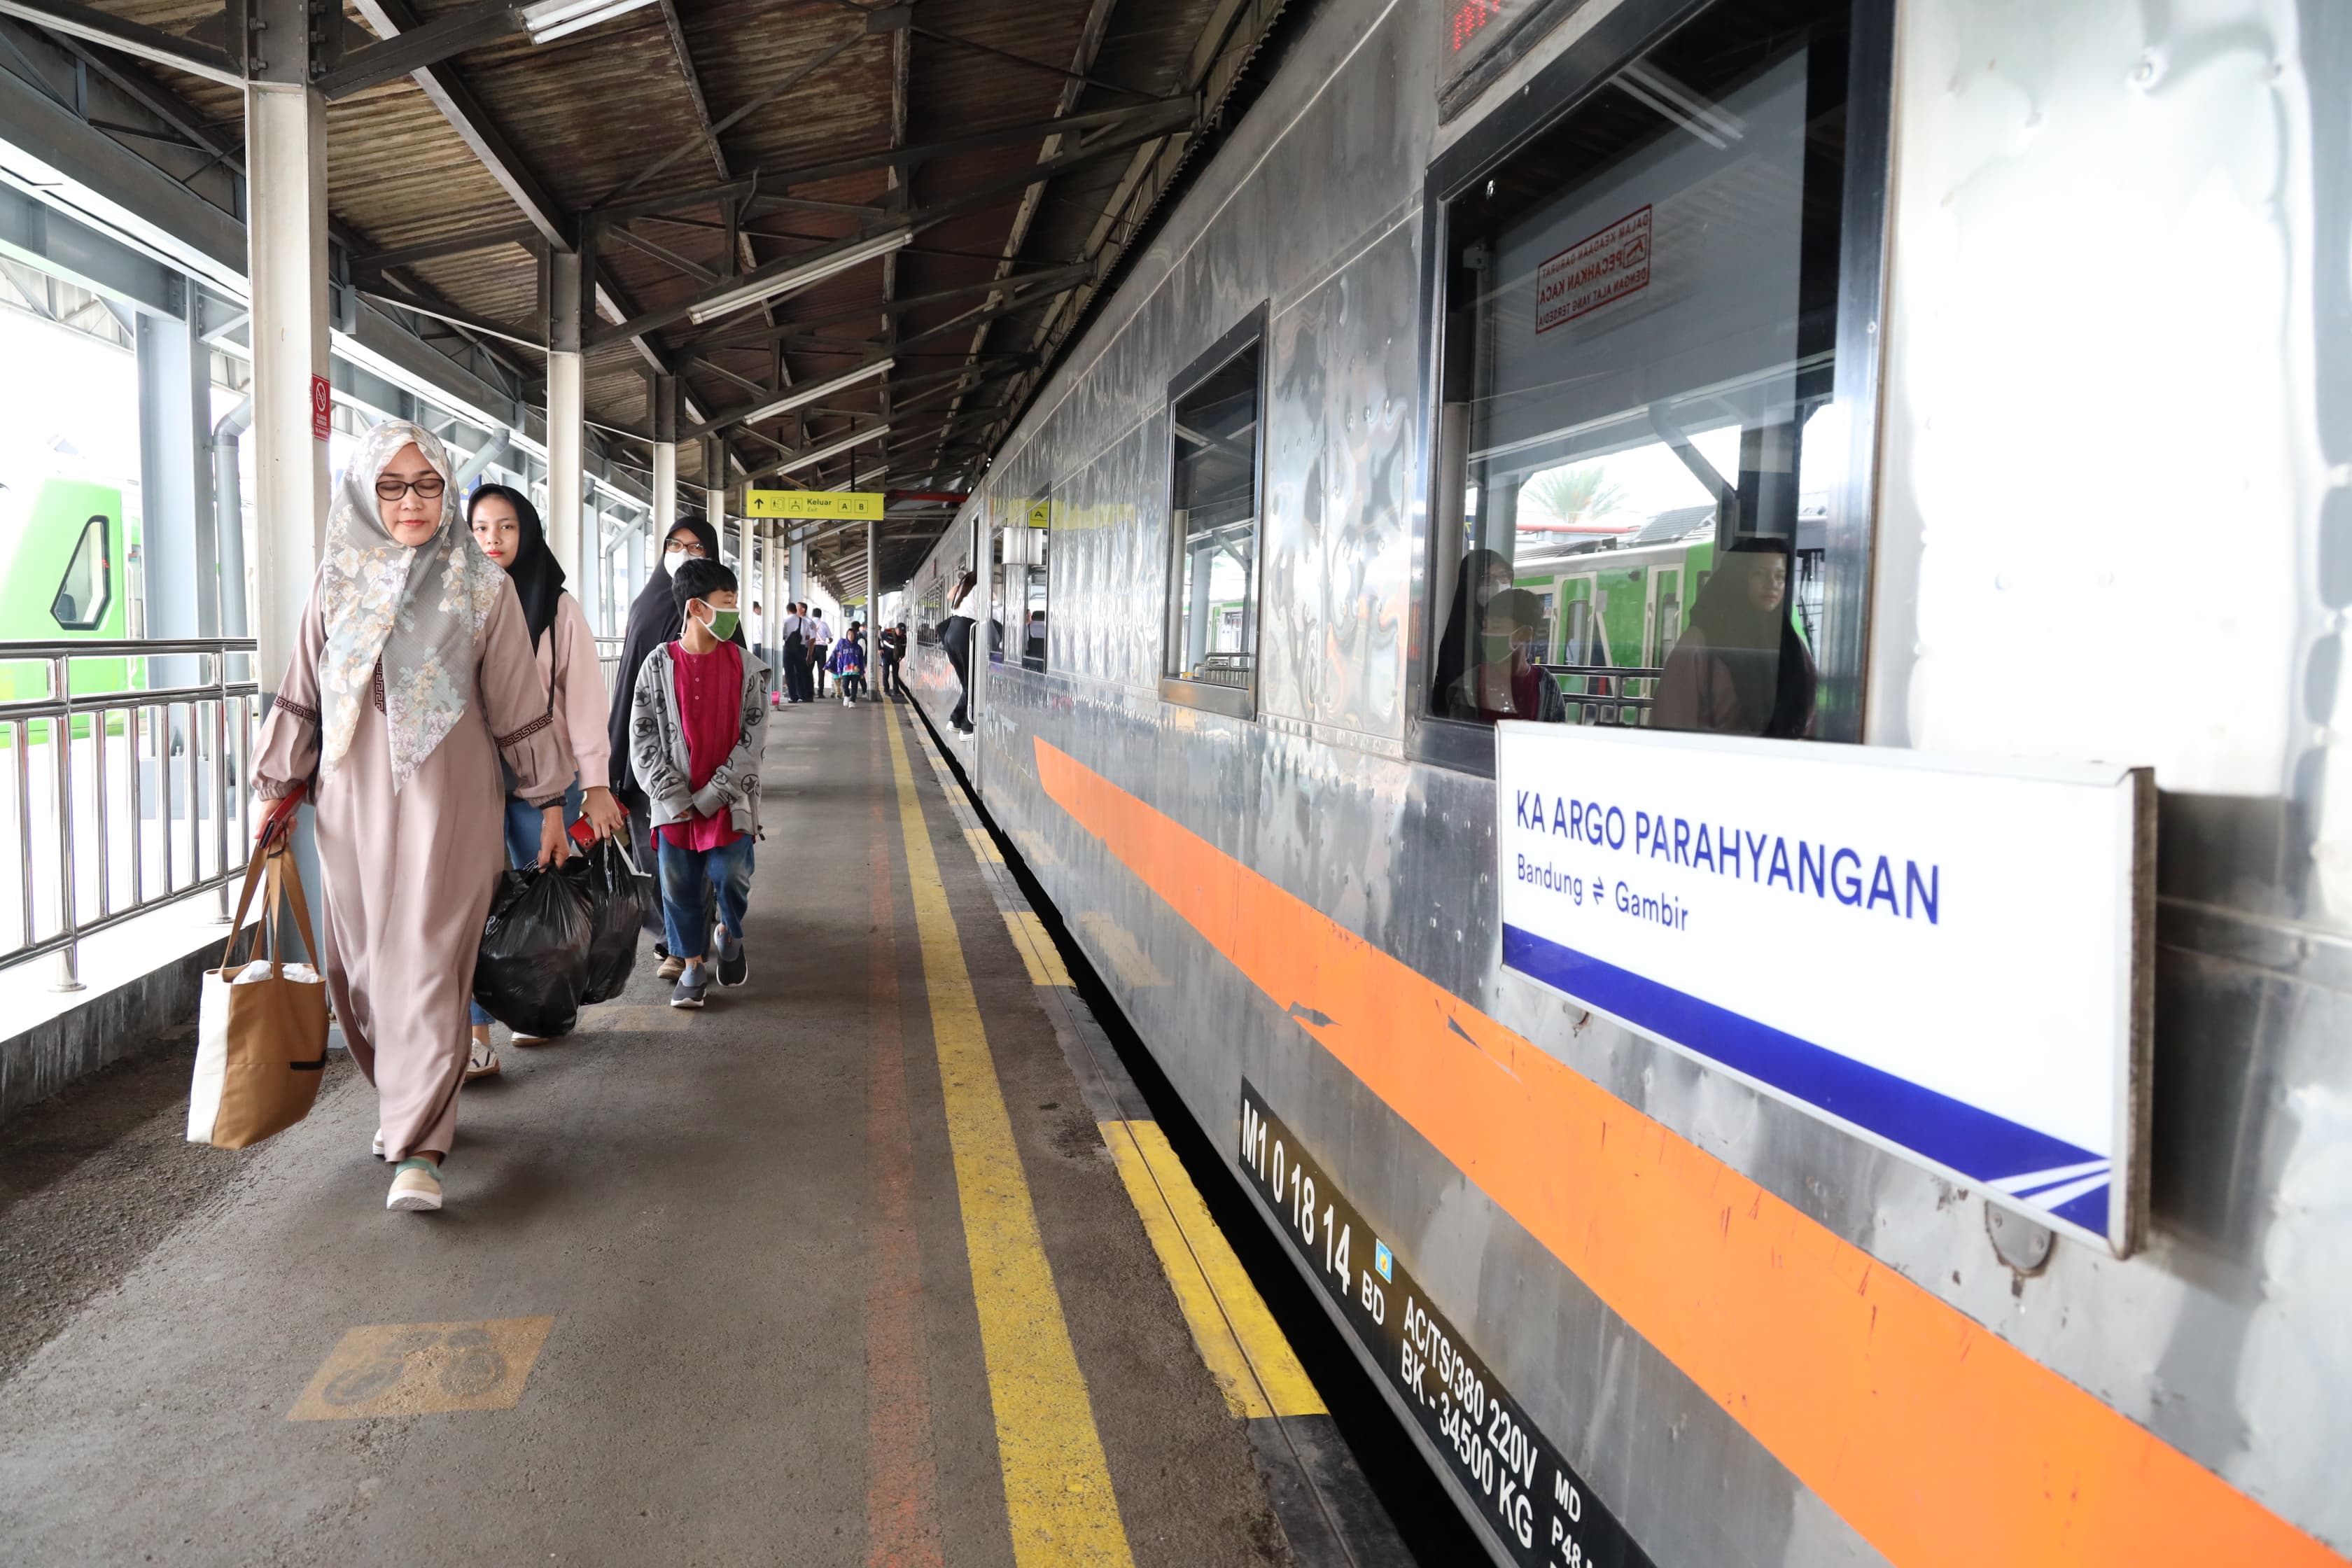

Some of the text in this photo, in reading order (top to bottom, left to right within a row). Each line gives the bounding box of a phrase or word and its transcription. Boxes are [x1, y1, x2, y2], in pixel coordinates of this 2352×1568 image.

[1517, 790, 1939, 925] KA ARGO PARAHYANGAN
[1517, 853, 1688, 931] Bandung Gambir
[1362, 1270, 1385, 1325] BD
[1401, 1338, 1425, 1405] BK
[1439, 1392, 1492, 1495] 34500
[1499, 1468, 1533, 1548] KG
[1488, 1399, 1538, 1489] 220V
[1555, 1469, 1581, 1522] MD
